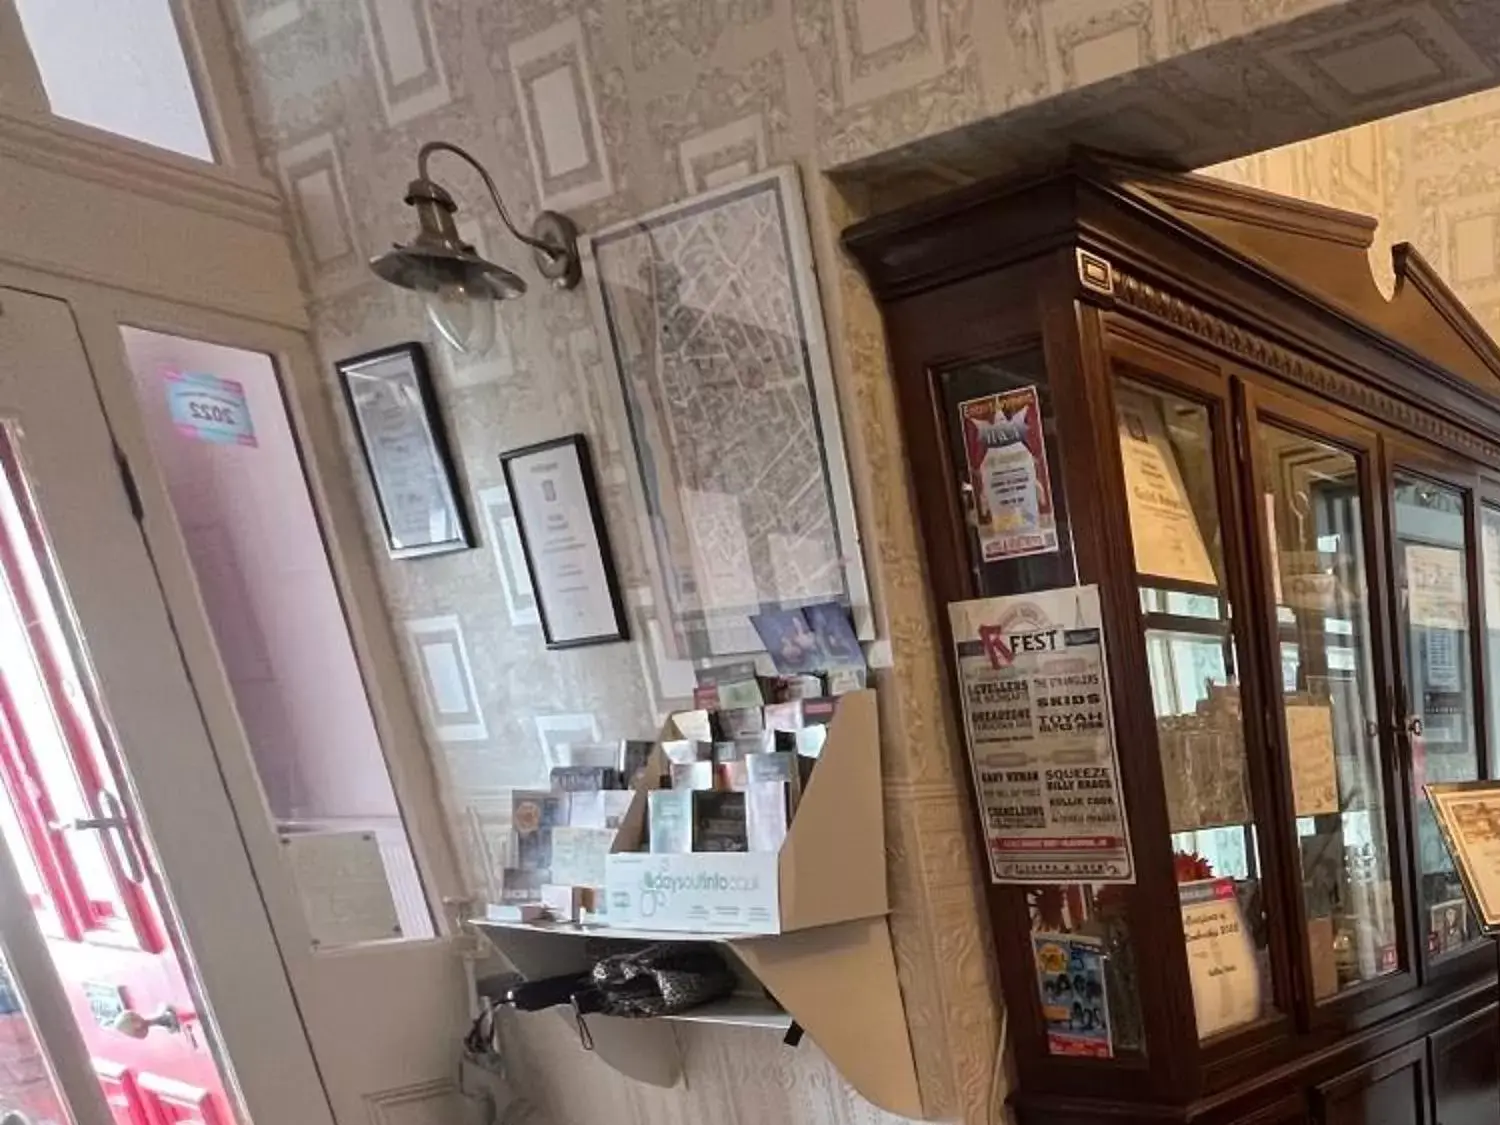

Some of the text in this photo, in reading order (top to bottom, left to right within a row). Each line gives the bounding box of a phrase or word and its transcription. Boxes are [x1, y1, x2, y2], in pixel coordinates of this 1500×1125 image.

[1009, 630, 1057, 653] FEST
[1036, 694, 1101, 707] SKIDS
[1038, 712, 1103, 724] TOYAH
[1045, 767, 1110, 780] SQUEEZE
